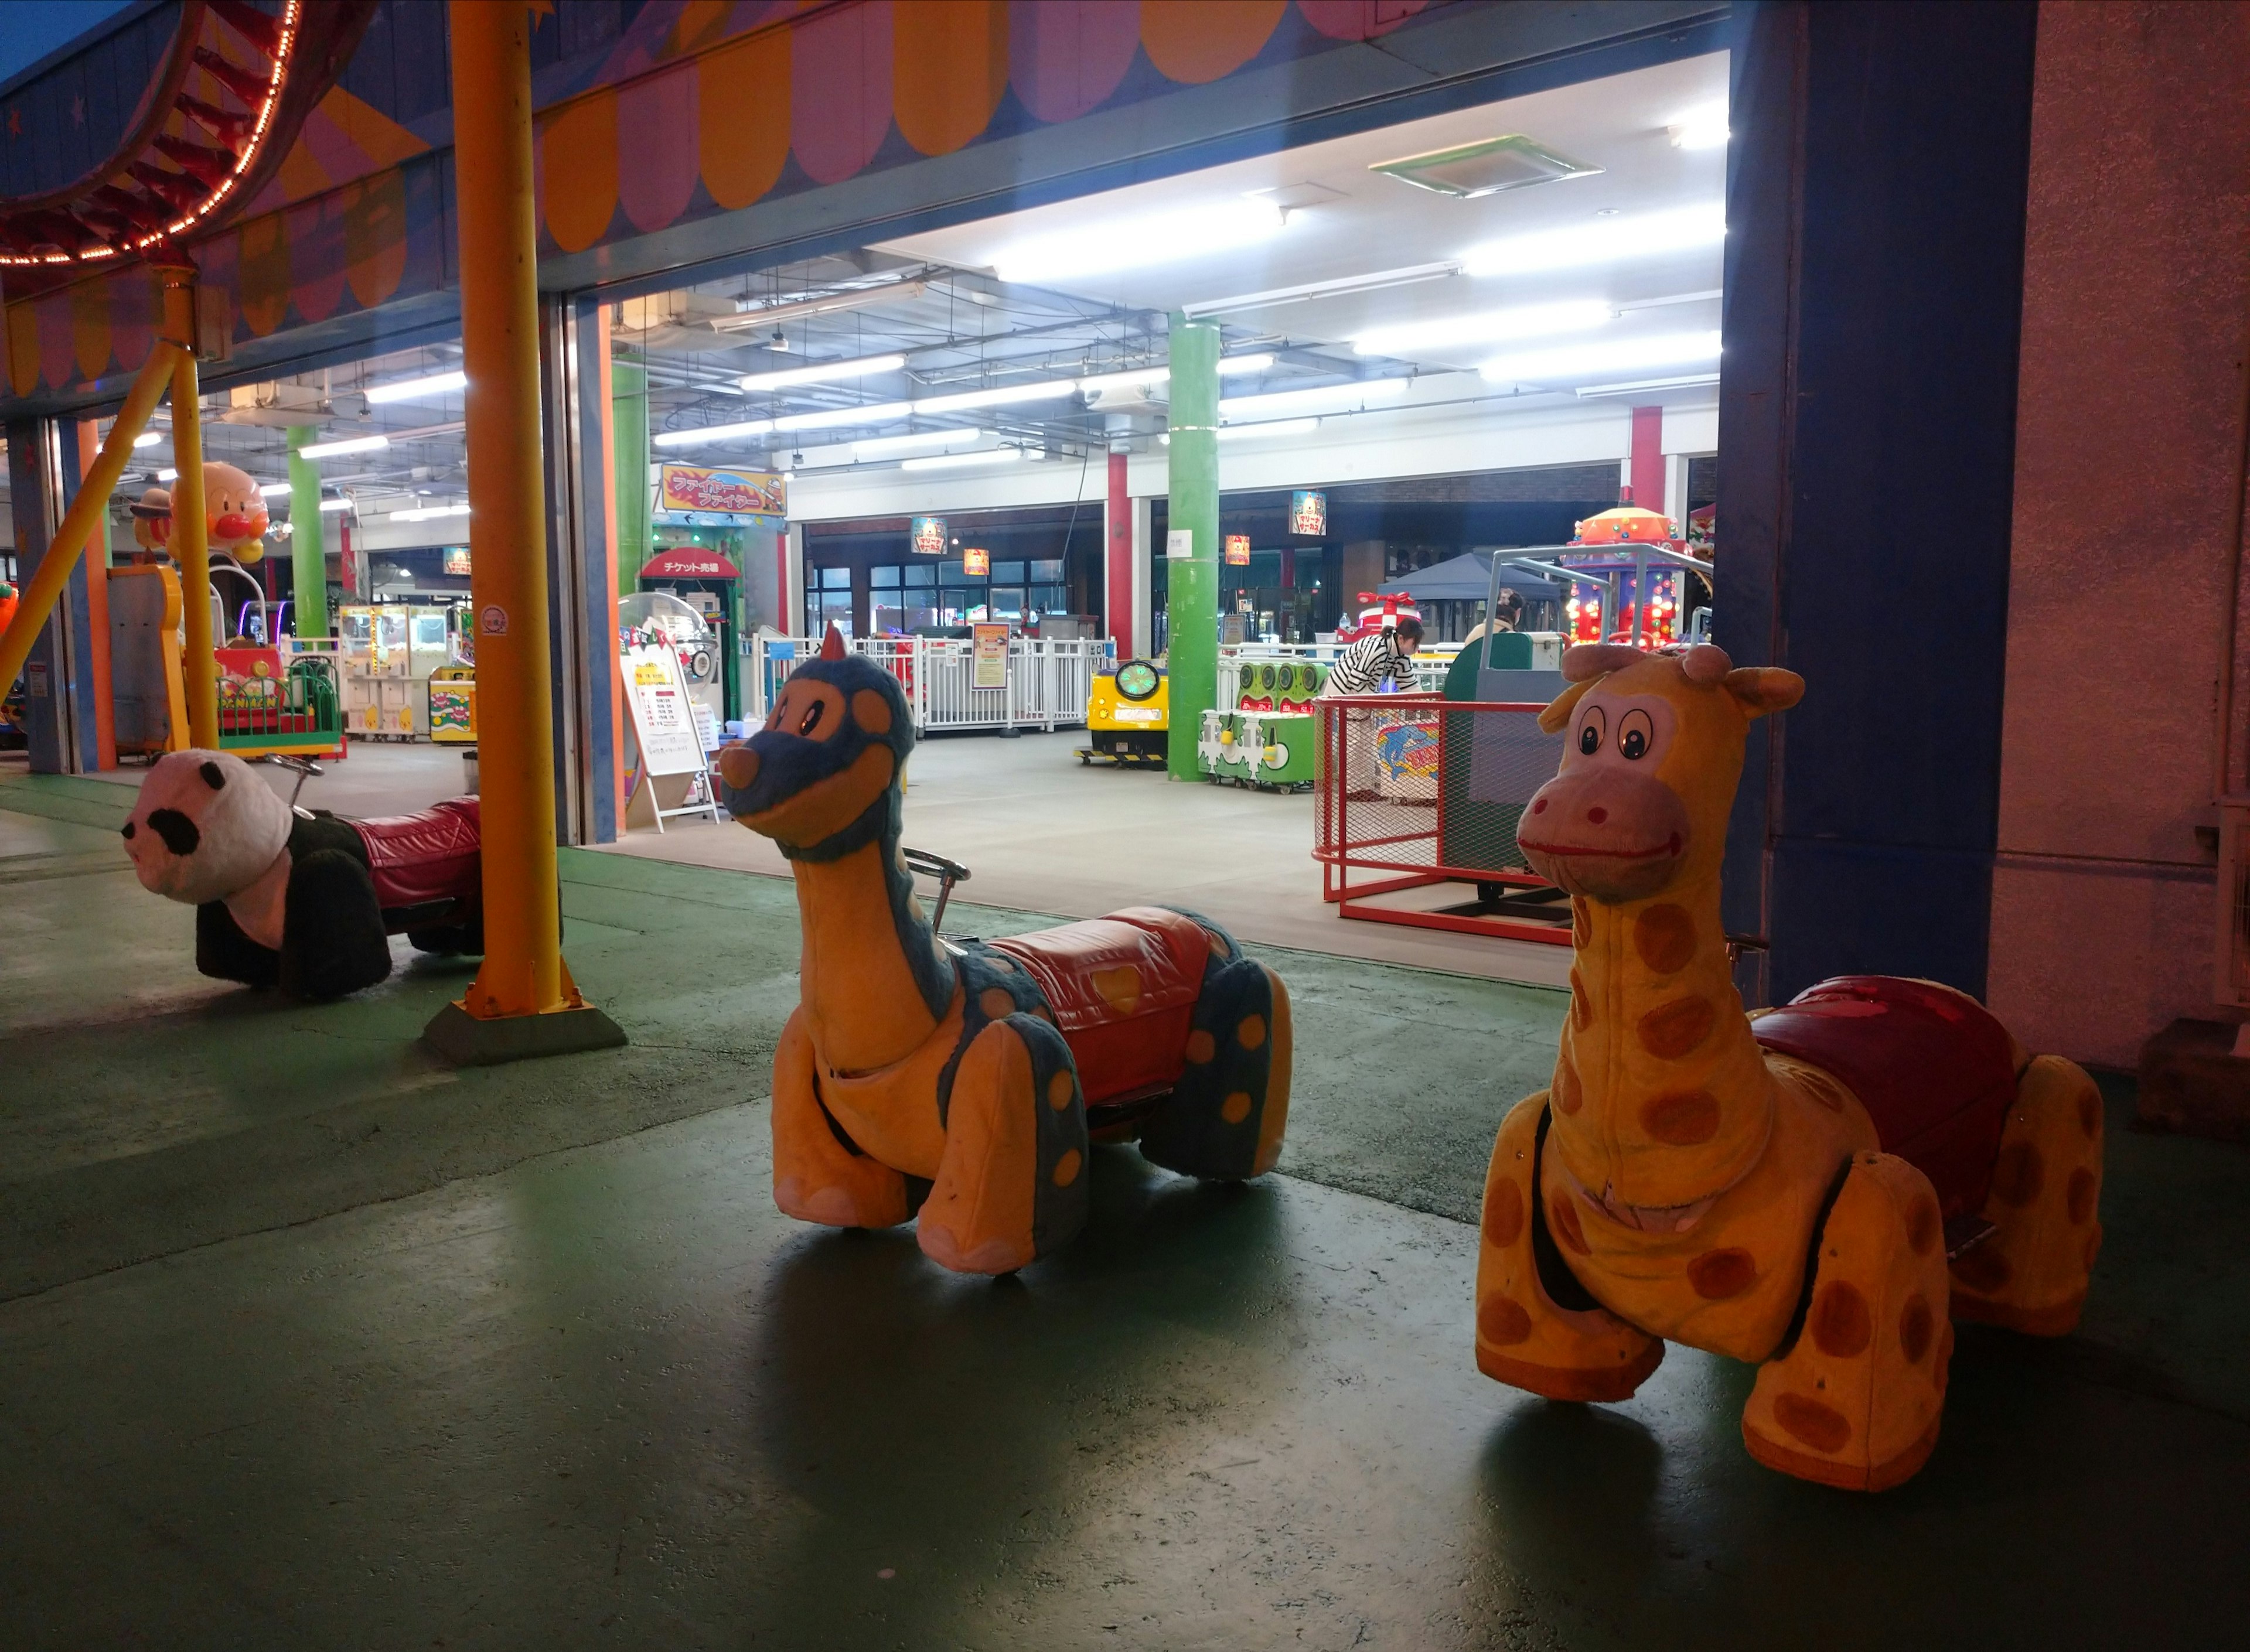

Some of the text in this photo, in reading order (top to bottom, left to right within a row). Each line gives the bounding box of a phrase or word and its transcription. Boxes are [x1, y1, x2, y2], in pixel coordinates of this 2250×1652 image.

[673, 476, 736, 494] ファイヤー
[698, 493, 759, 509] ファイター
[664, 562, 719, 572] チケット売場
